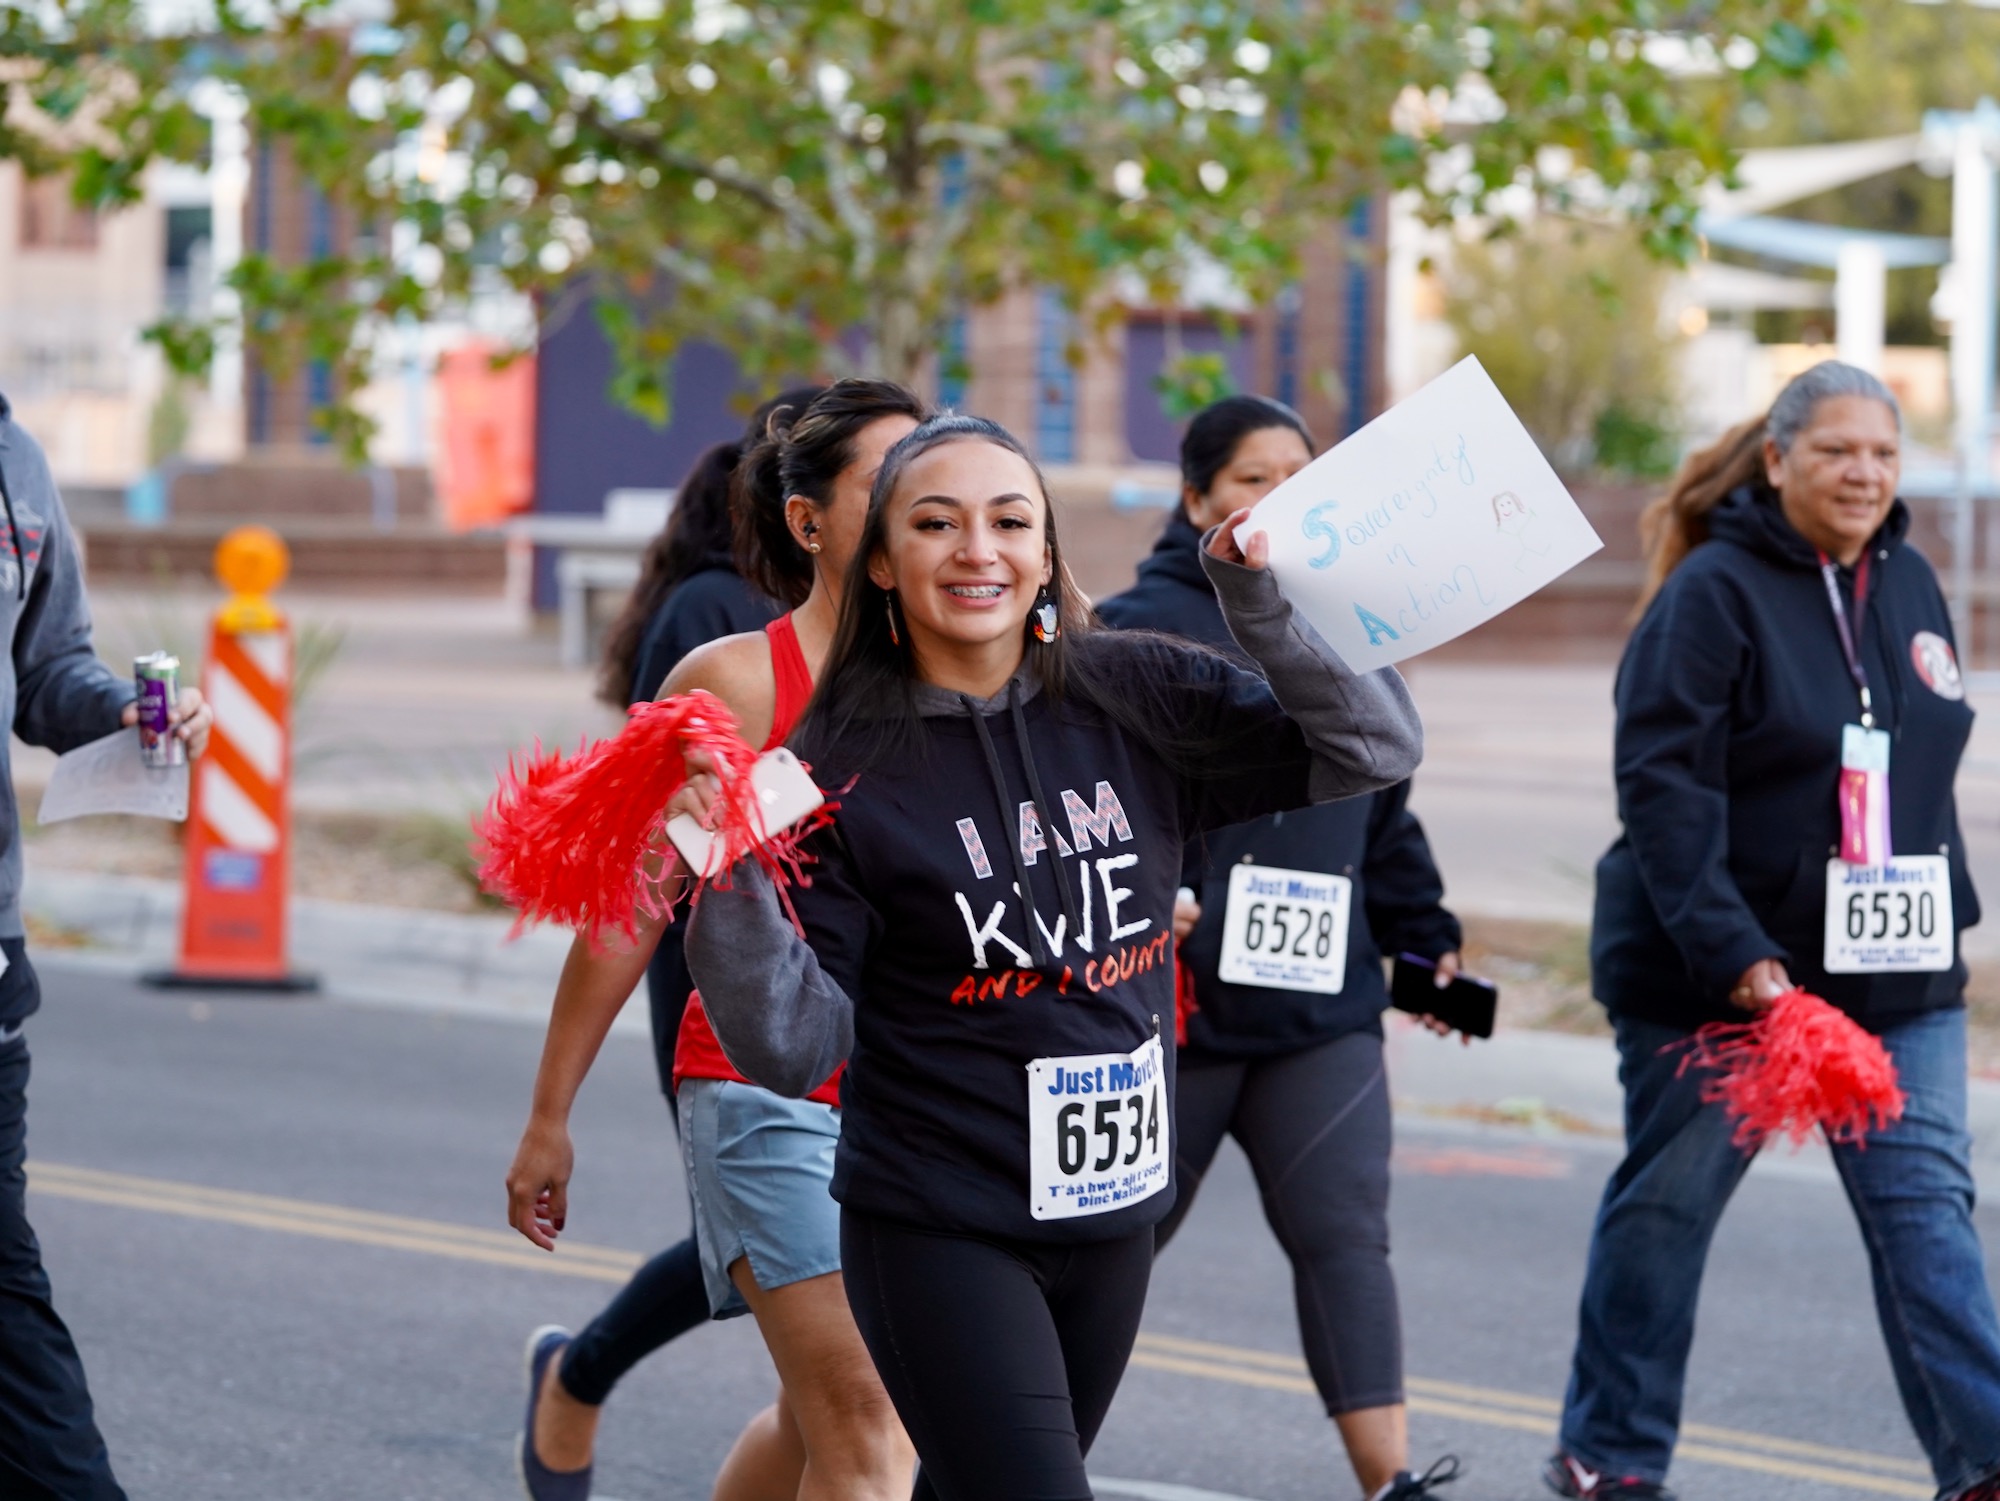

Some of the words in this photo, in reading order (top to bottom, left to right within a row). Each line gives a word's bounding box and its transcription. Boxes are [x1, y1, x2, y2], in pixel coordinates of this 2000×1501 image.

[1302, 431, 1476, 570] Sovereignty
[1386, 542, 1418, 568] in
[1352, 564, 1497, 647] Action
[955, 816, 994, 880] I
[1018, 780, 1134, 867] AM
[1246, 903, 1333, 959] 6528
[1847, 891, 1936, 940] 6530
[951, 969, 1044, 1005] AND
[1058, 965, 1073, 996] I
[1085, 929, 1170, 993] COUNT
[1048, 1067, 1104, 1096] Just
[1057, 1083, 1160, 1176] 6534
